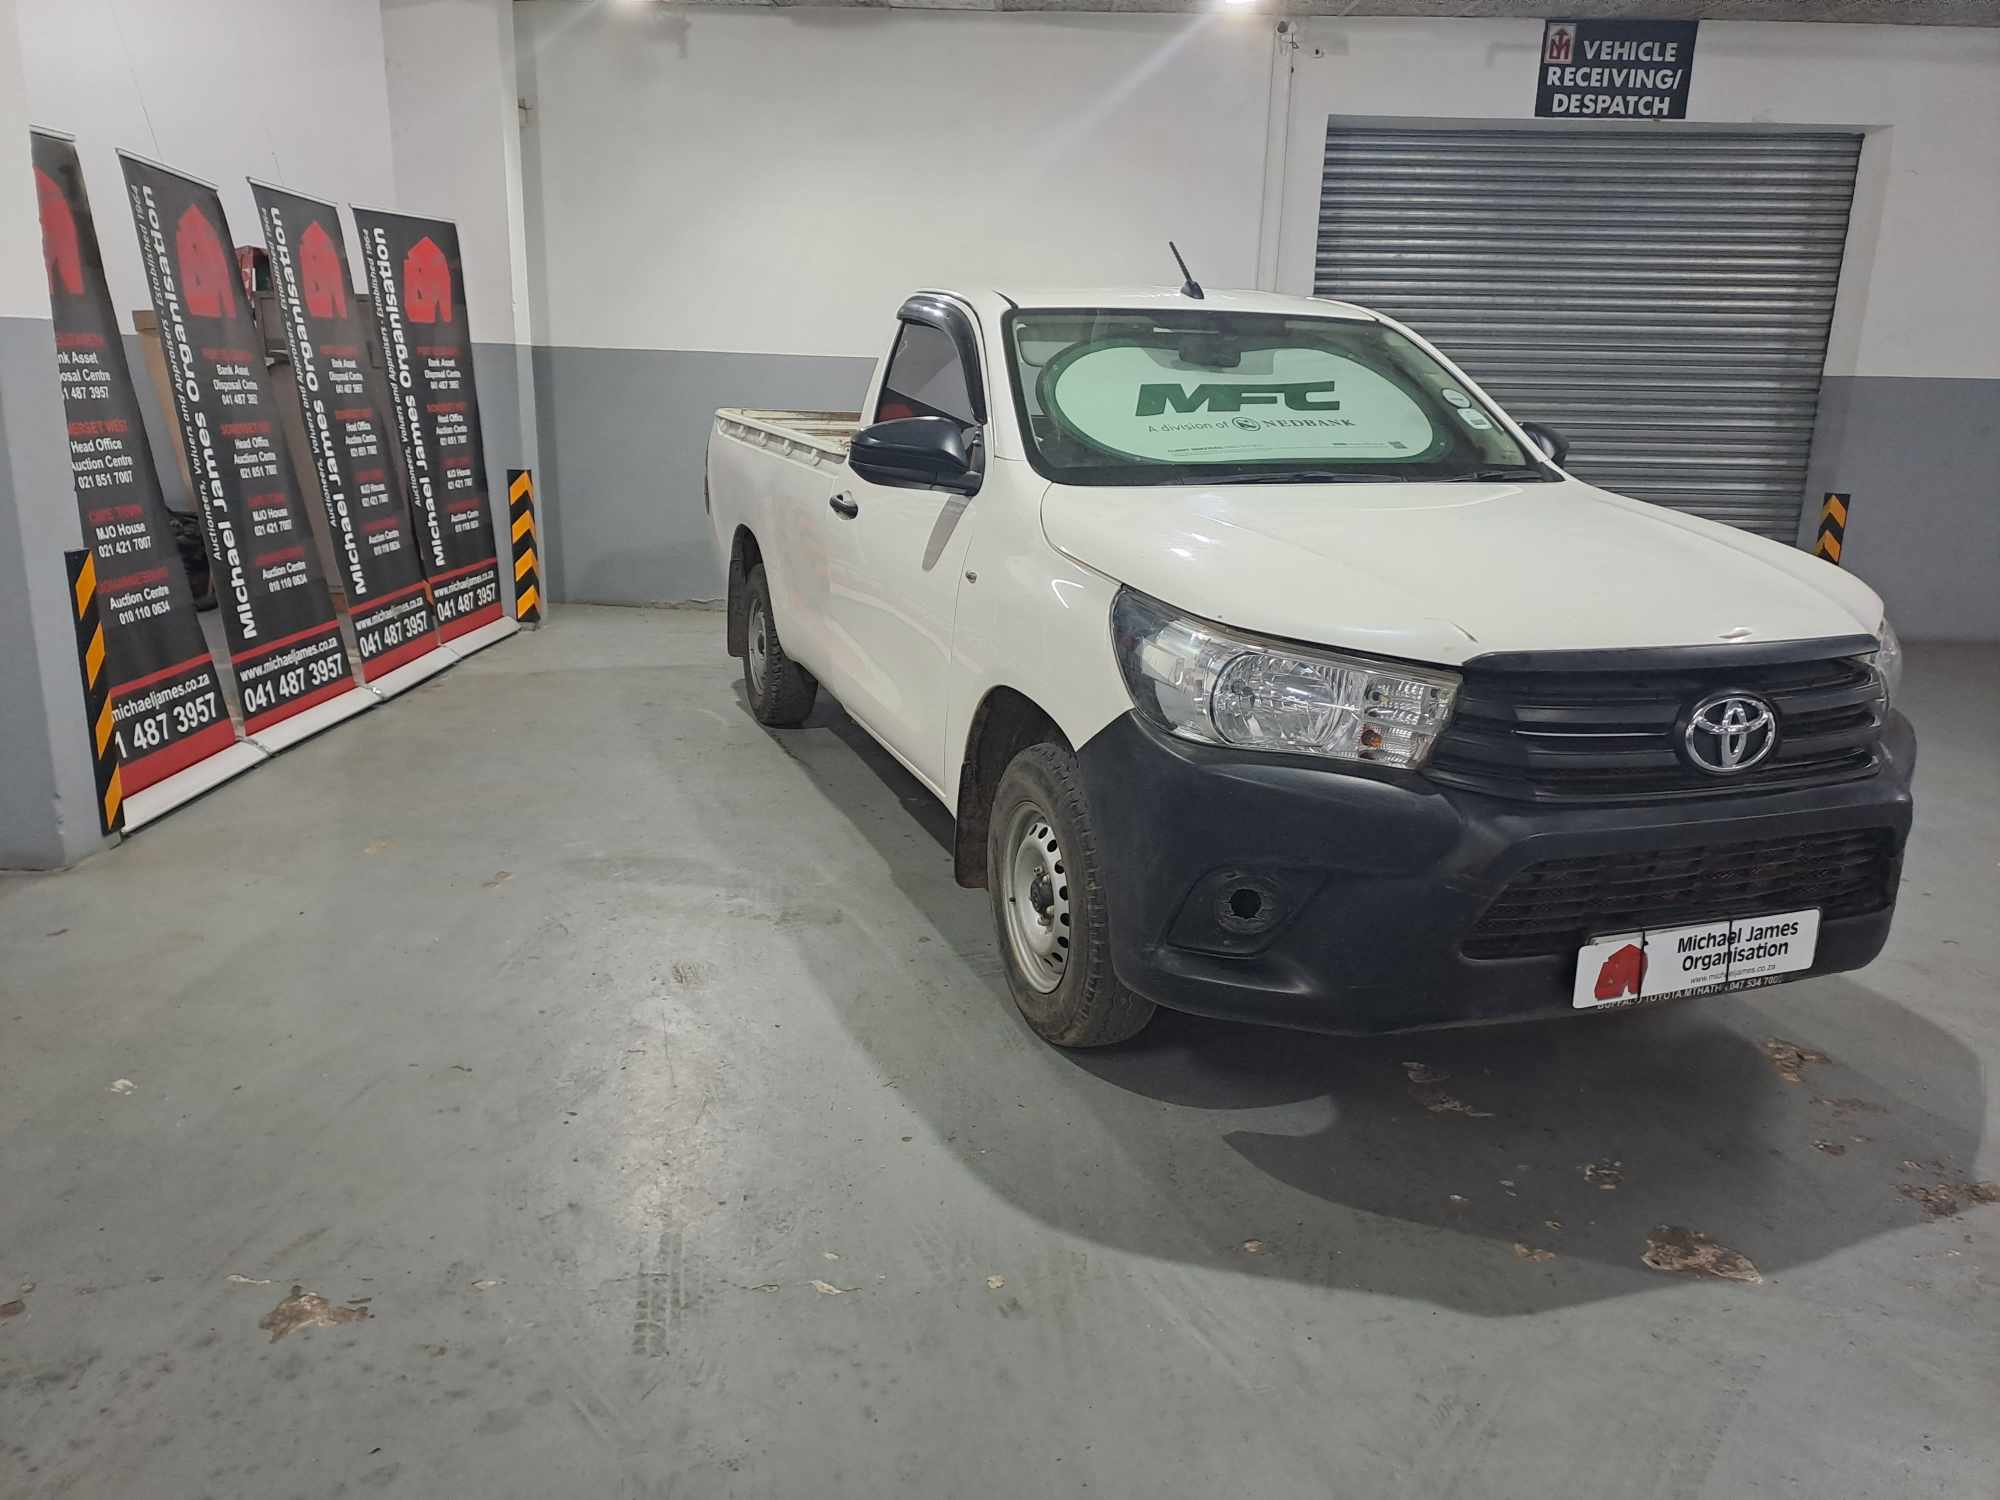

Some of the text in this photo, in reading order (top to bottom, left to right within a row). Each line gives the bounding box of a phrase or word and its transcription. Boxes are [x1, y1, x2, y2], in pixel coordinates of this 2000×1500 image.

[1583, 40, 1678, 62] VEHICLE
[1546, 66, 1683, 90] RECEIVING/
[1552, 93, 1671, 116] DESPATCH
[271, 207, 319, 392] Organisation
[71, 387, 86, 400] 487
[373, 228, 446, 567] Michael James Organisation
[1135, 381, 1340, 416] MFC
[142, 185, 258, 639] Michael James Organisation
[1161, 421, 1212, 432] division
[1215, 418, 1229, 429] of
[1262, 418, 1356, 428] NEDBANK
[70, 437, 123, 453] Head Office
[313, 400, 341, 486] James
[78, 475, 94, 489] 021
[95, 473, 112, 487] 851
[95, 522, 146, 540] MJO House
[333, 493, 367, 595] Michael
[98, 544, 114, 558] 021
[115, 540, 132, 554] 421
[110, 591, 143, 610] Auction
[119, 610, 134, 625] 010
[135, 605, 151, 620] 110
[437, 583, 496, 622] 041 487 3957
[359, 611, 428, 657] 041 487 3957
[240, 637, 338, 682] www.michaeljames.co.za
[112, 672, 211, 722] michaeljames.co.za
[244, 653, 343, 712] 041 487 3957
[133, 712, 169, 750] 487
[173, 691, 217, 733] 3957
[1677, 922, 1798, 953] Michael James
[1682, 942, 1789, 971] Organisation
